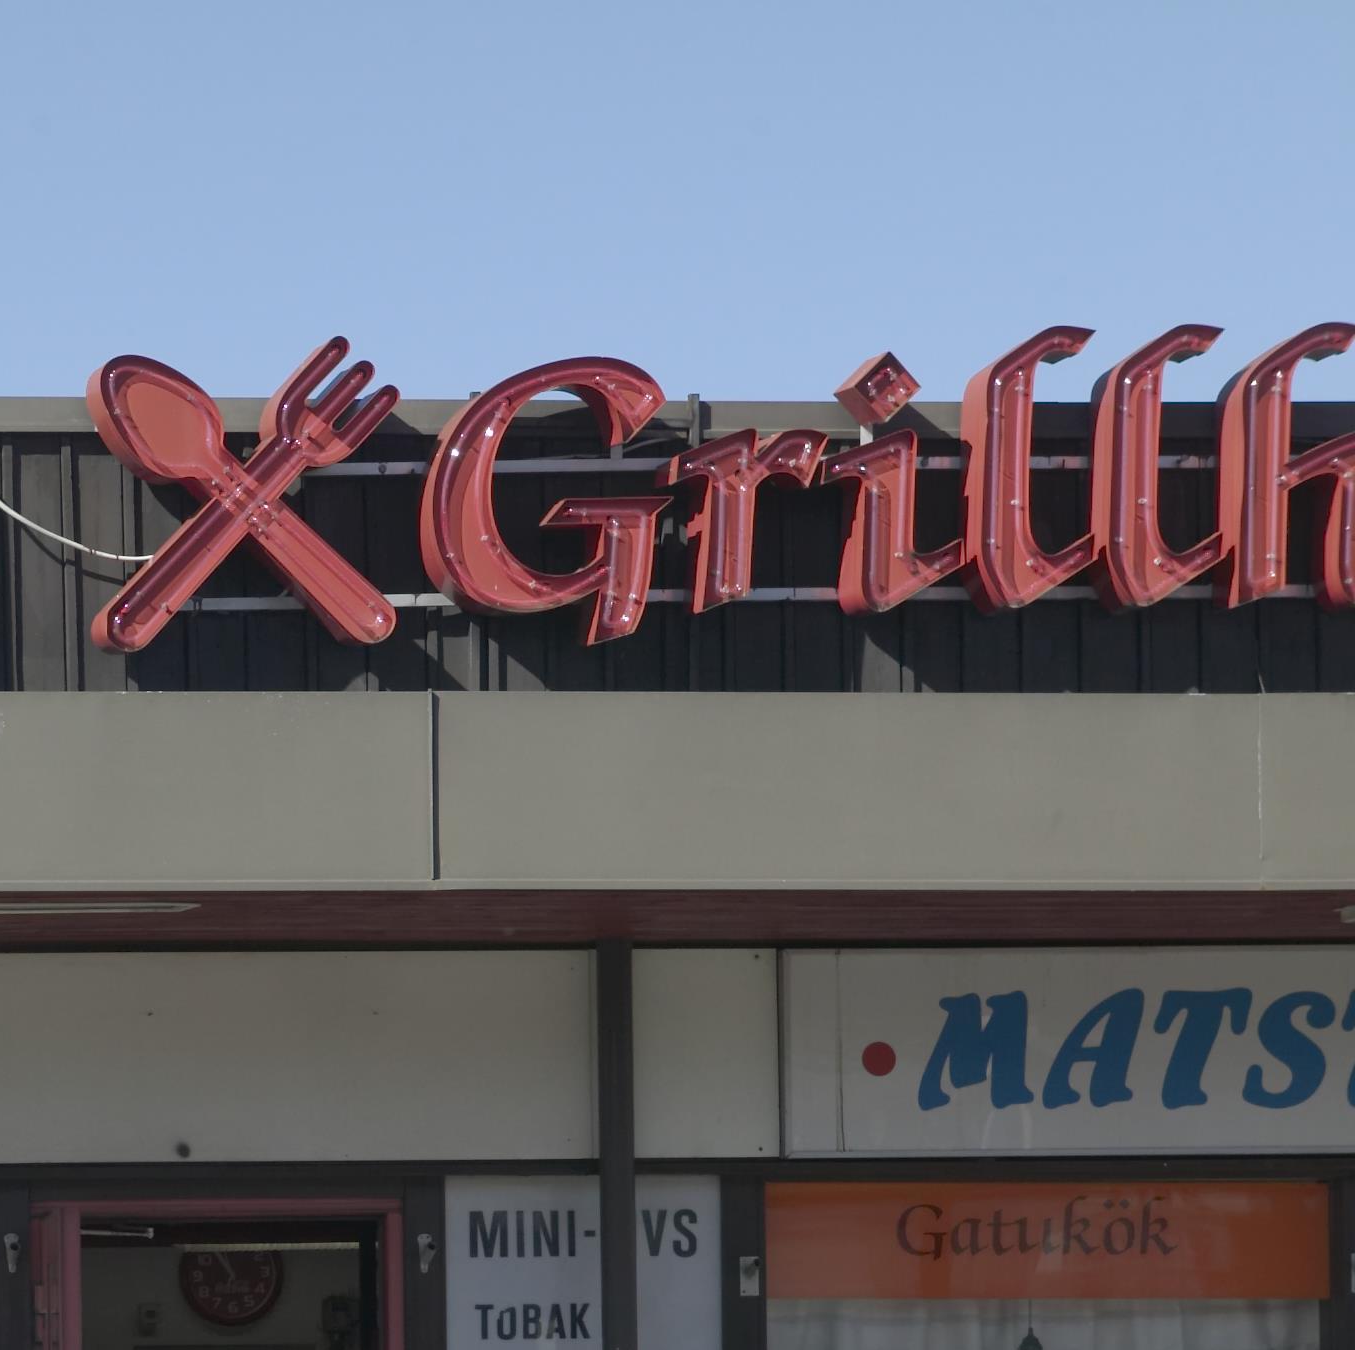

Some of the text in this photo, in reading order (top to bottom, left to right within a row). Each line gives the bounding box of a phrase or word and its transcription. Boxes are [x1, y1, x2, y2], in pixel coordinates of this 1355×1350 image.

[469, 1209, 698, 1258] MINI-VS
[896, 1195, 1178, 1261] Gatukök
[475, 1303, 591, 1340] TOBAK
